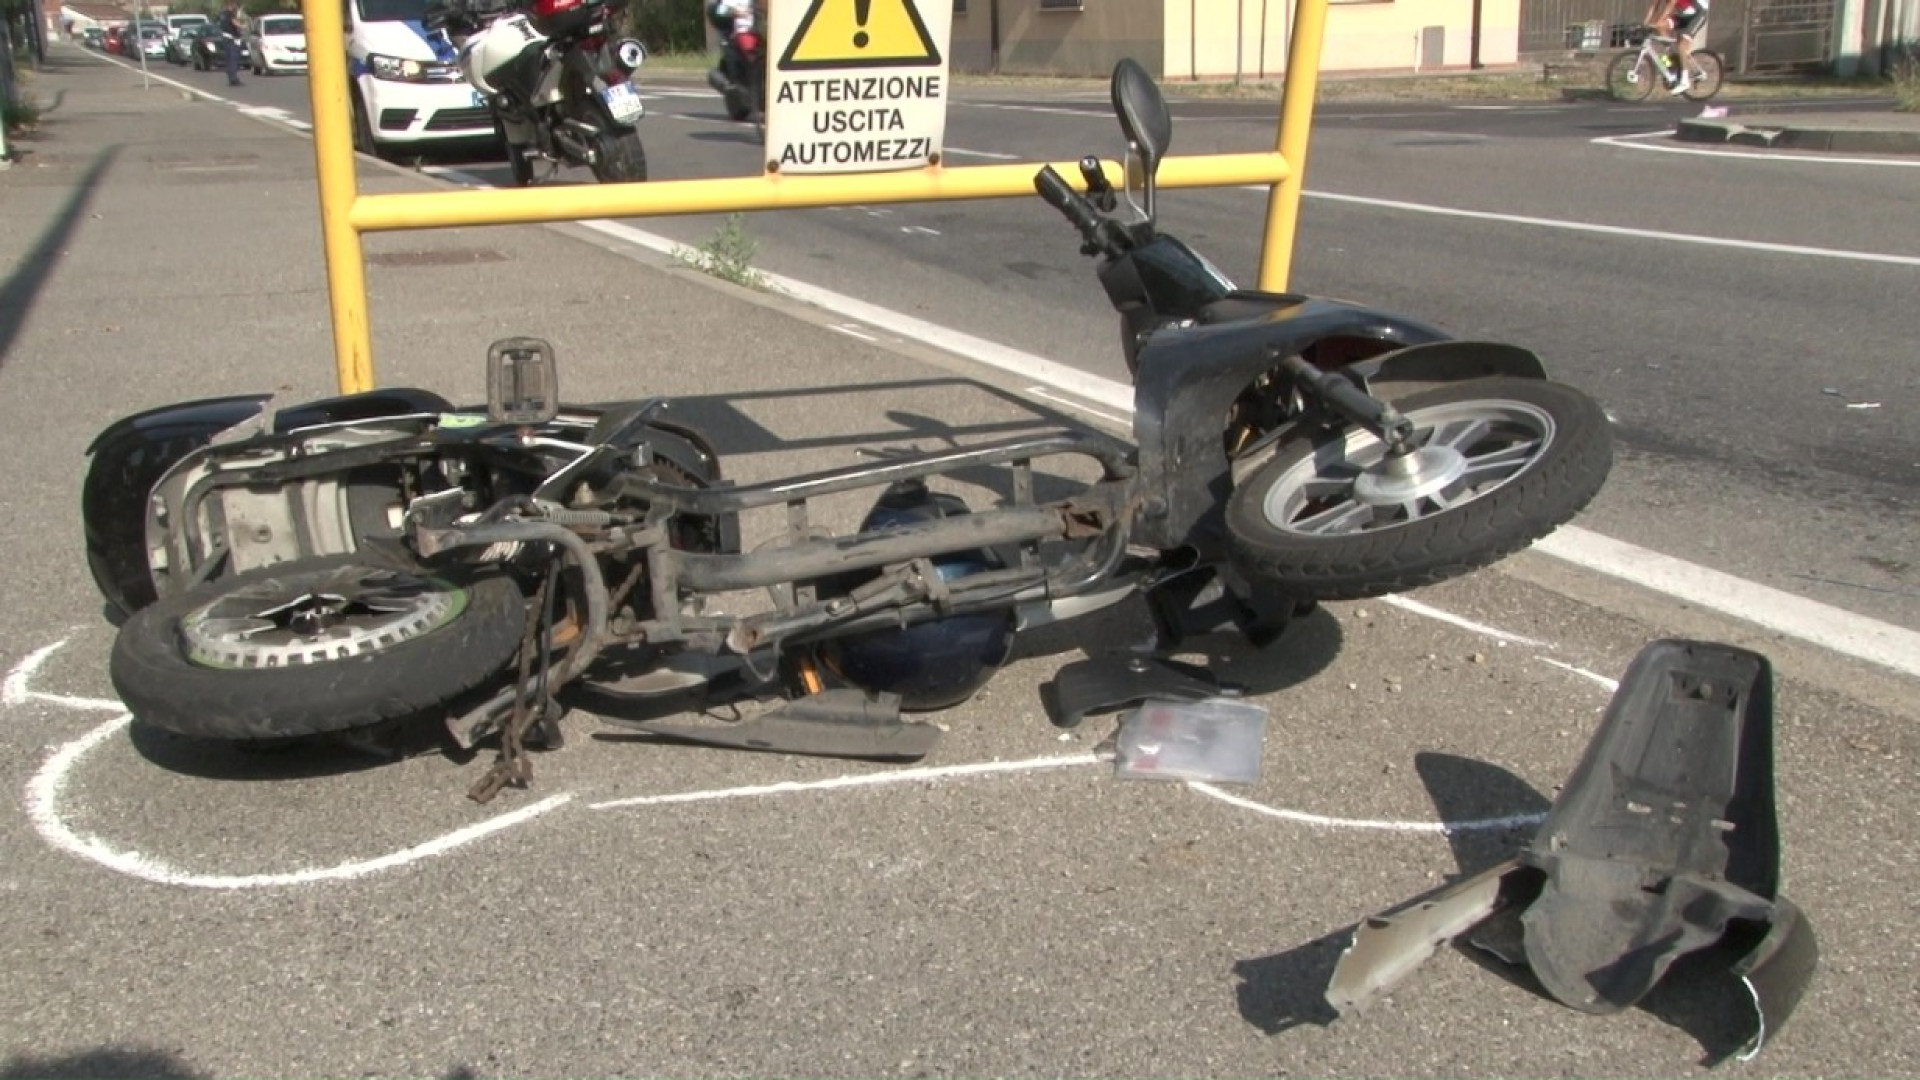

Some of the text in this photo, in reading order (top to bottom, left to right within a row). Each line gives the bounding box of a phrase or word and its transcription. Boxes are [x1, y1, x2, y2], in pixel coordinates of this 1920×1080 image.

[776, 76, 941, 103] ATTENZIONE
[813, 108, 904, 133] USCITA
[780, 137, 931, 165] AUTOMEZZI
